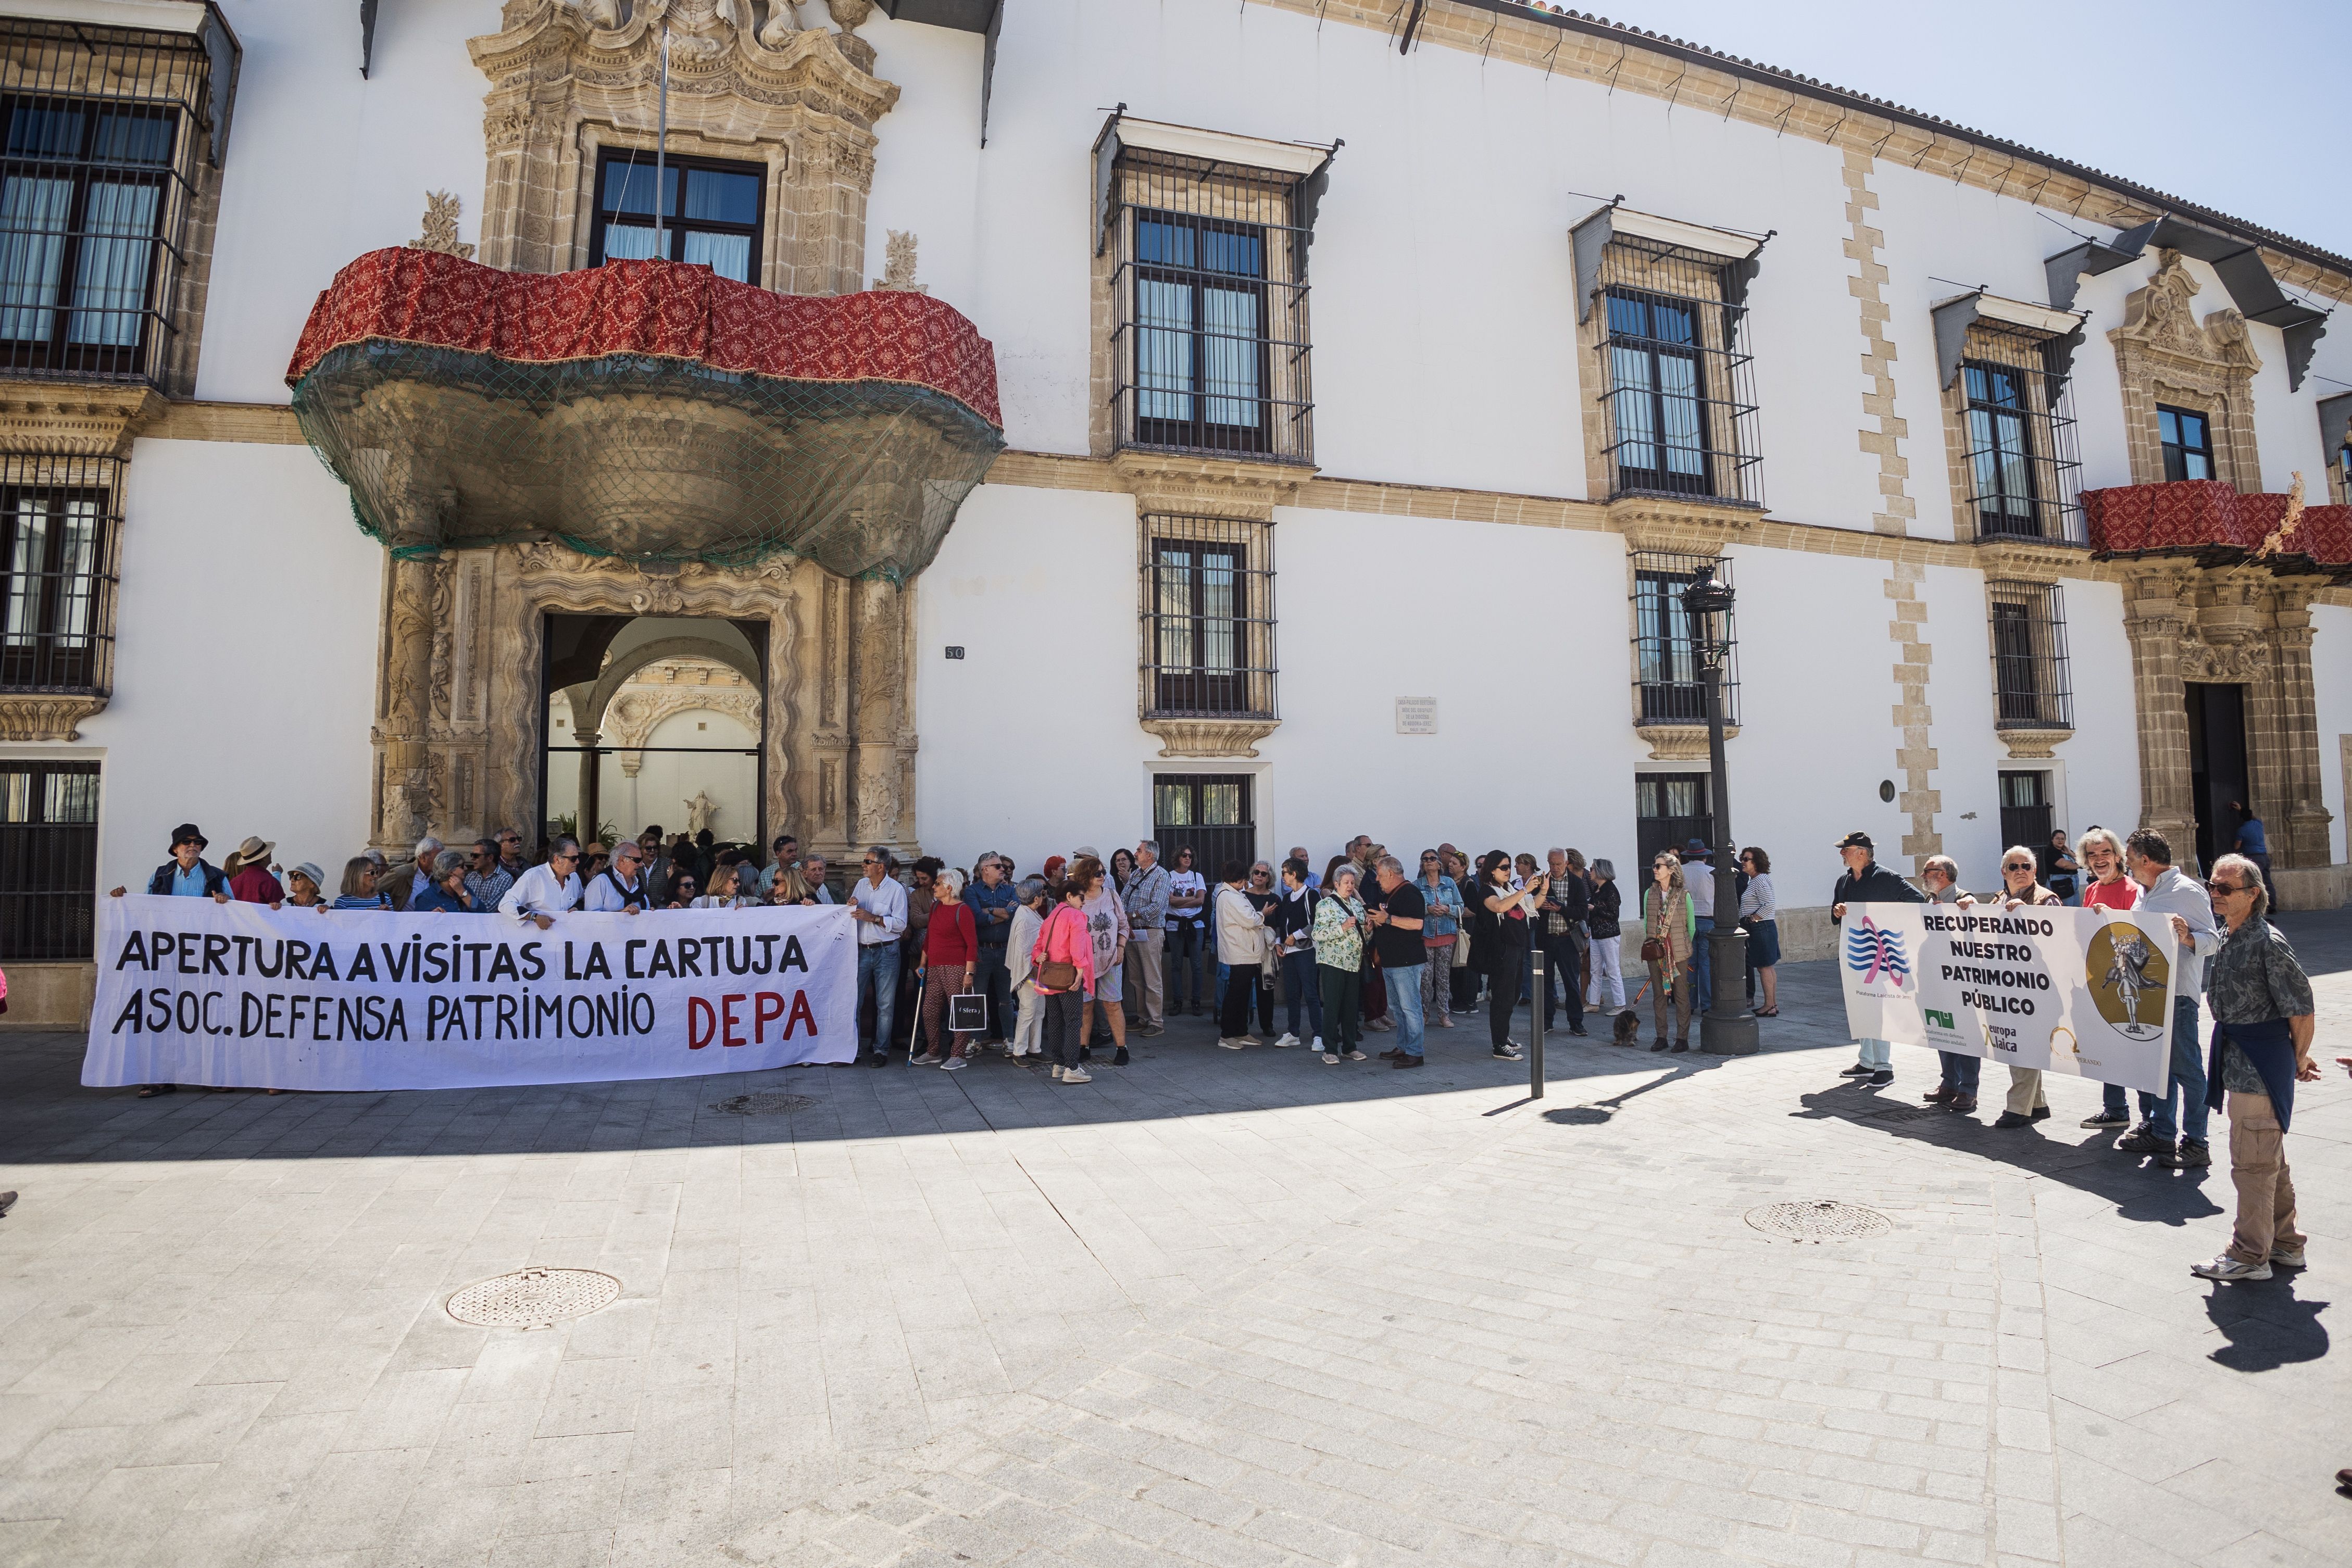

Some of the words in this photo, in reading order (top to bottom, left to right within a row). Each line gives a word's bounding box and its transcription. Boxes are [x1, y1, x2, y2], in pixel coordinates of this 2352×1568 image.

[947, 647, 964, 658] 50
[1924, 915, 2053, 937] RECUPERANDO
[116, 930, 340, 981] APERTURA
[346, 943, 378, 982] A
[565, 941, 612, 981] LA
[625, 935, 809, 979] CARTUJA
[1950, 940, 2032, 962] NUESTRO
[1942, 965, 2050, 990] PATRIMONIO
[1962, 988, 2035, 1016] PÚBLICO
[689, 989, 818, 1050] DEPA
[1989, 1025, 2017, 1038] europa
[1995, 1036, 2017, 1052] laica
